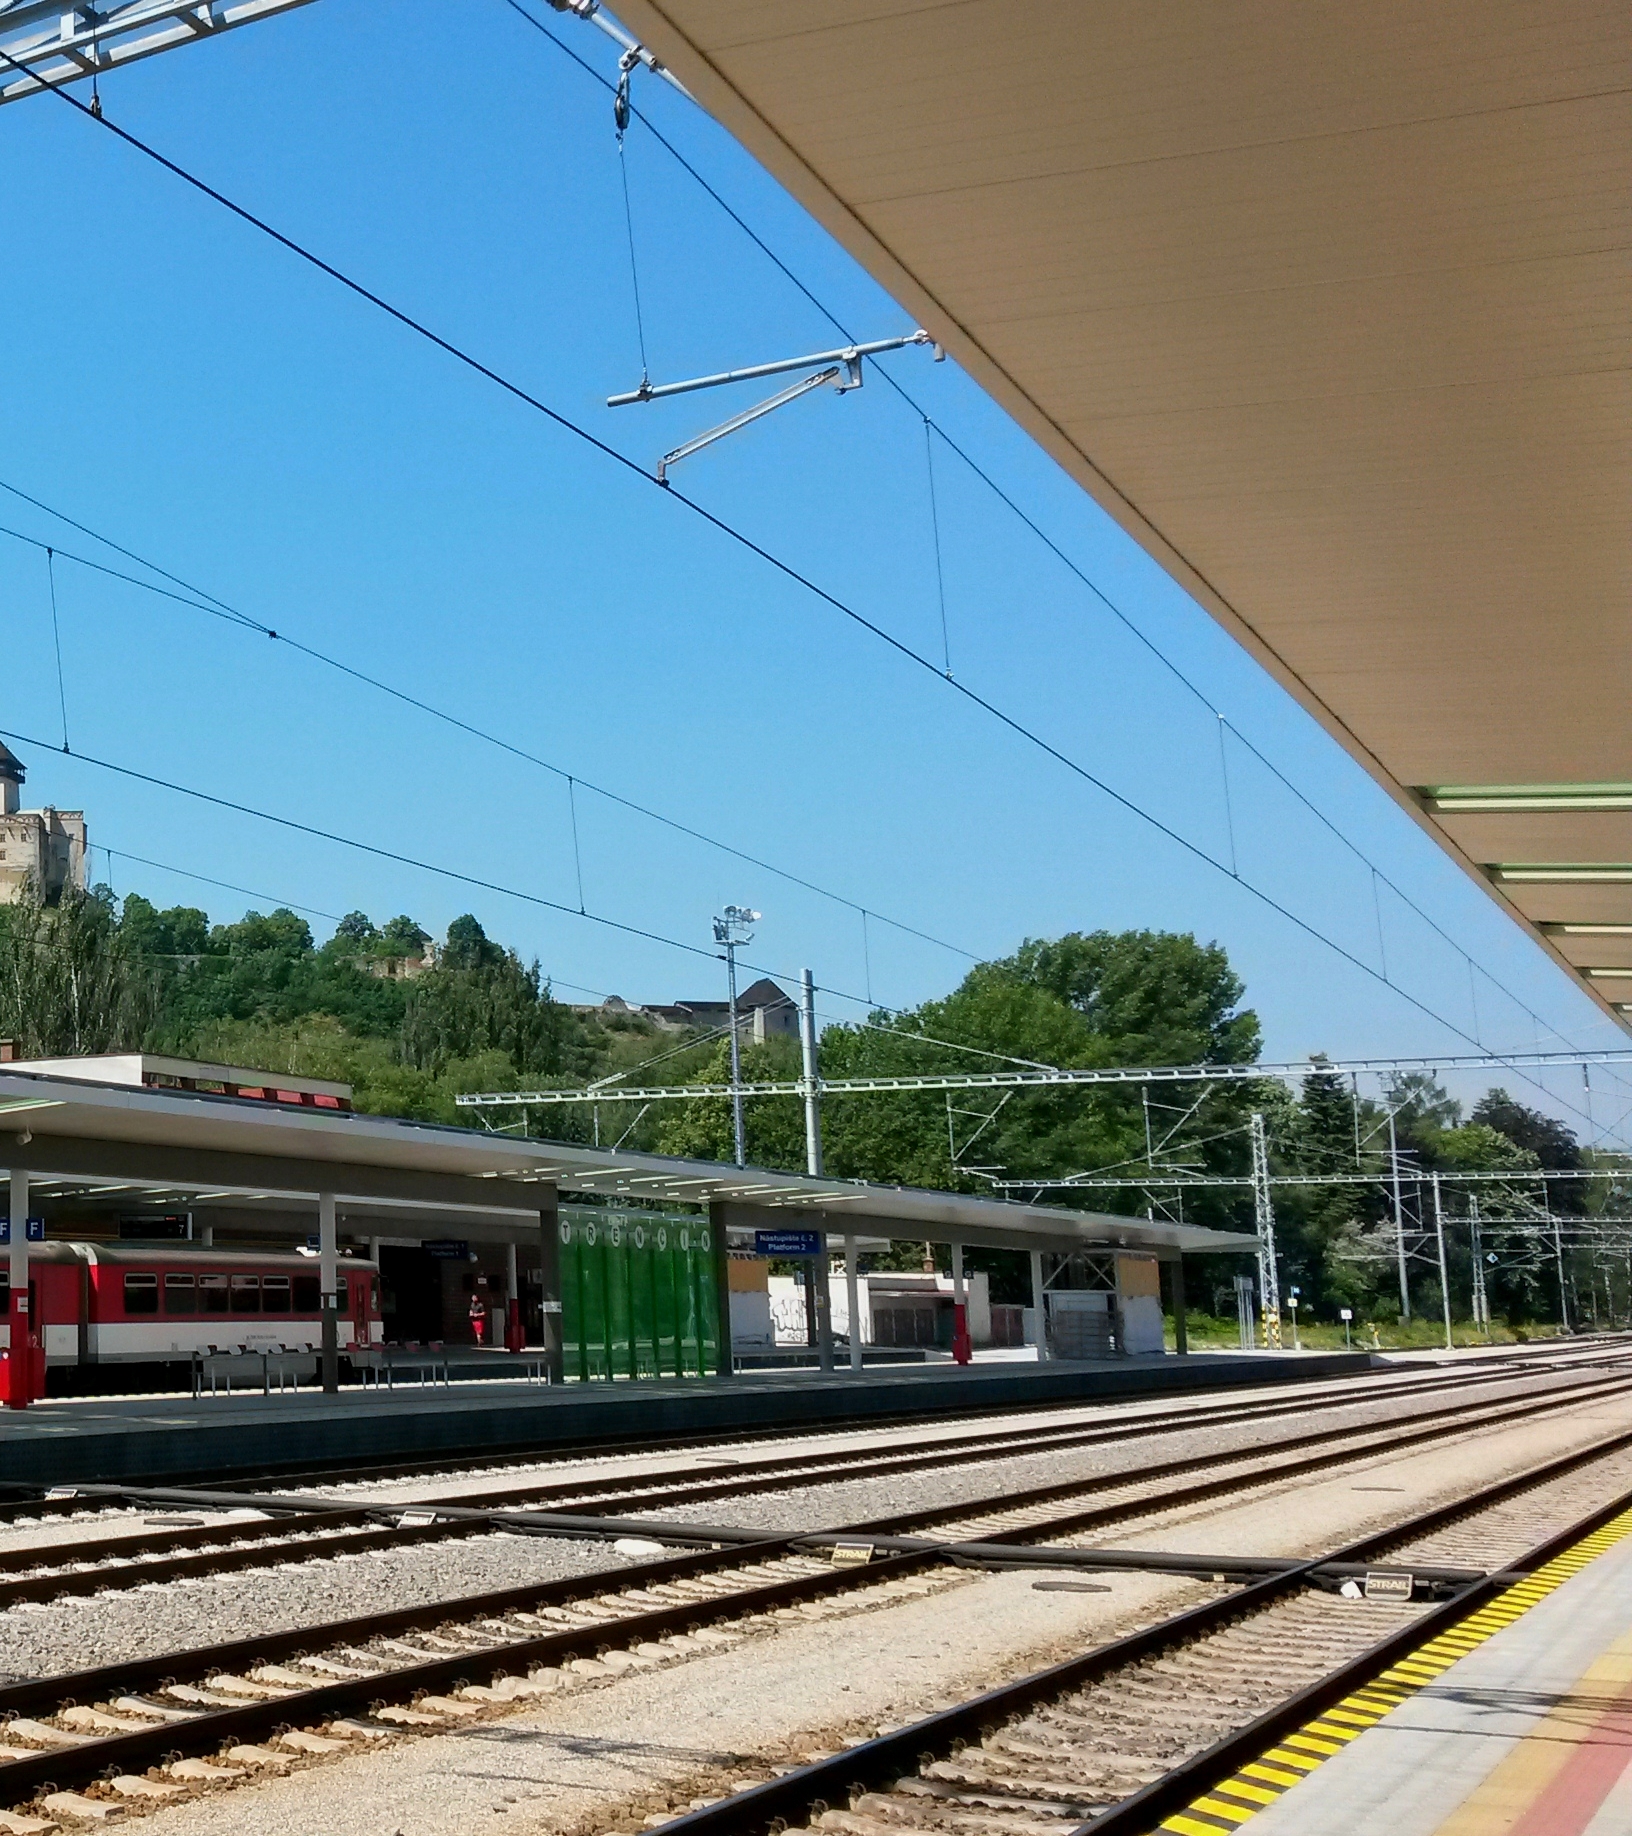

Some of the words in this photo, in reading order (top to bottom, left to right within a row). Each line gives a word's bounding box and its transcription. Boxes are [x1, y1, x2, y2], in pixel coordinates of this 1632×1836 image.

[0, 1222, 8, 1236] F
[29, 1222, 39, 1236] F
[178, 1224, 185, 1235] 7
[809, 1234, 814, 1242] 2
[768, 1243, 800, 1251] Platform
[1369, 1579, 1409, 1590] STRAIL
